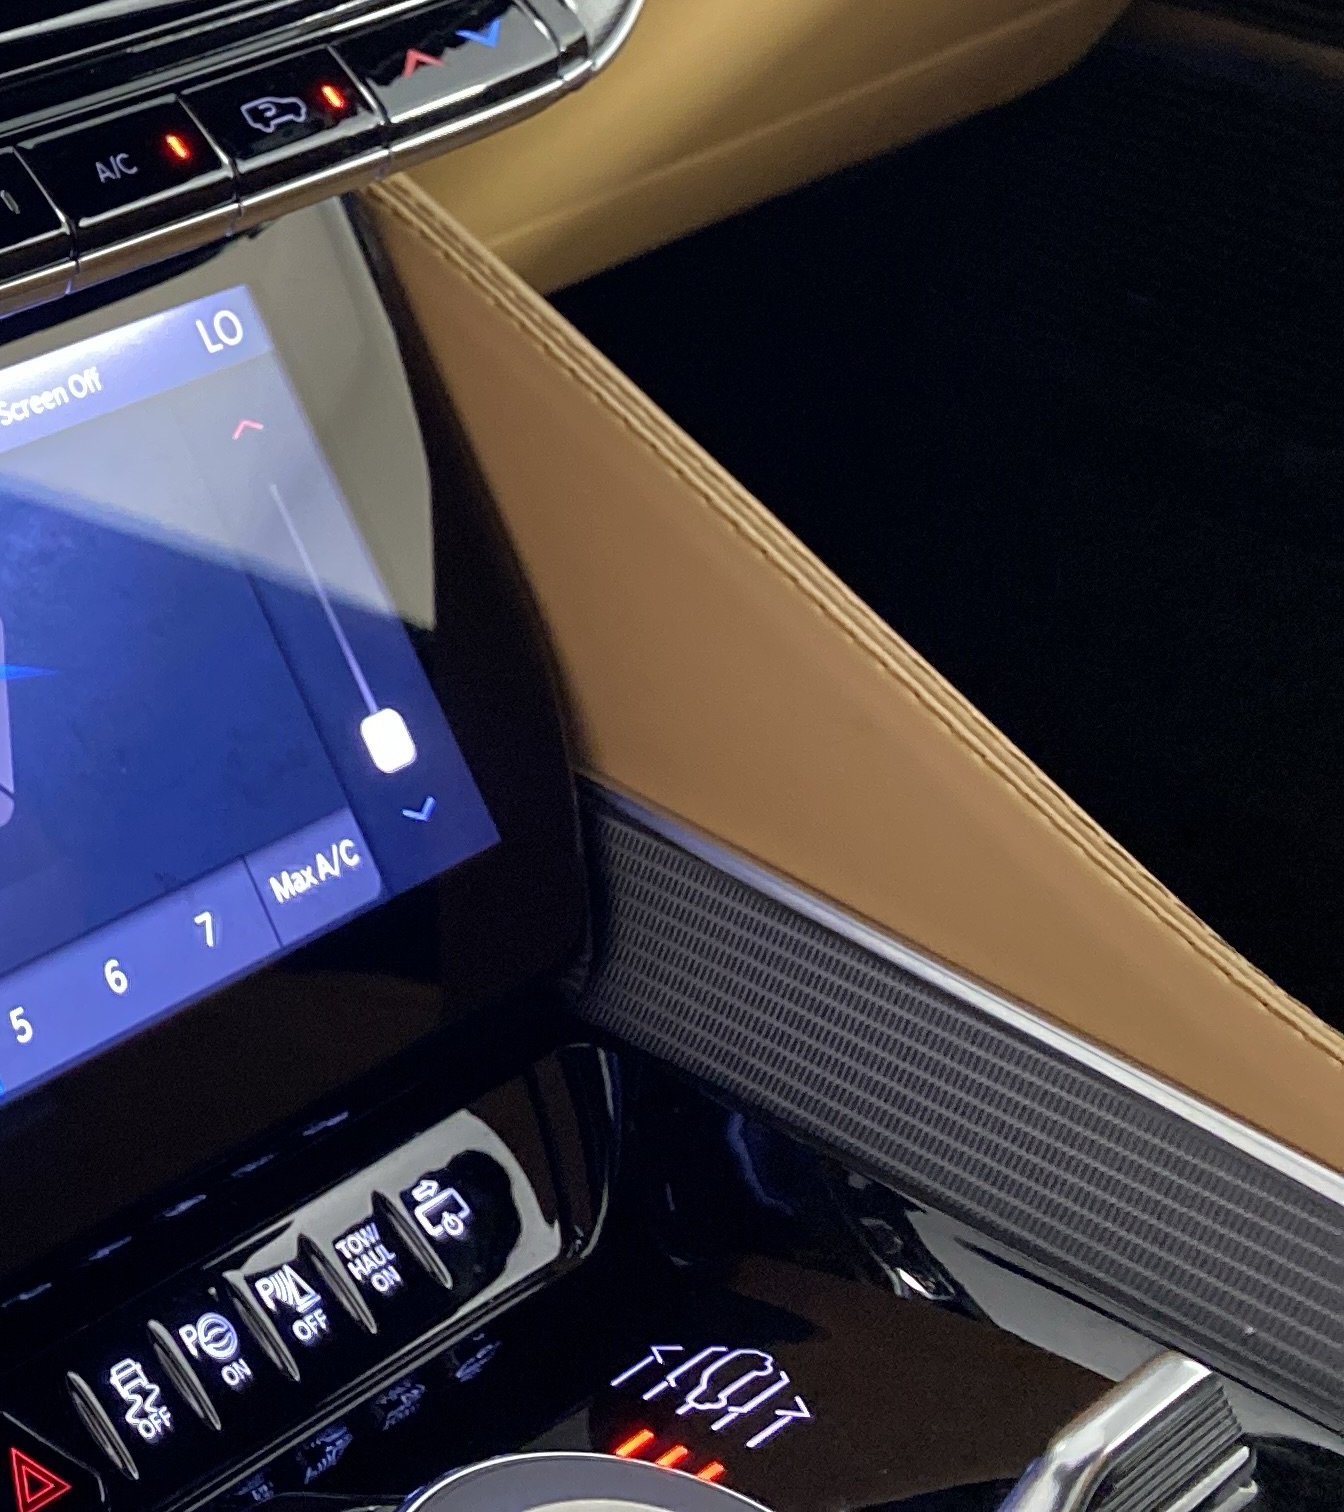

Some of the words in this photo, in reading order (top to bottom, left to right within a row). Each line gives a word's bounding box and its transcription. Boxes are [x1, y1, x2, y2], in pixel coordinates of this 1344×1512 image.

[96, 153, 138, 182] A/C
[196, 310, 243, 353] LO
[67, 366, 103, 402] Off
[269, 865, 318, 904] Max
[315, 838, 361, 882] A/C
[194, 912, 214, 946] 7
[105, 960, 127, 993] 6
[10, 1007, 32, 1043] 5
[336, 1223, 379, 1257] TOW/
[349, 1244, 396, 1278] HAUL
[371, 1265, 401, 1292] ON
[293, 1309, 326, 1342] OFF
[222, 1359, 251, 1386] ON
[136, 1406, 172, 1440] OFF
